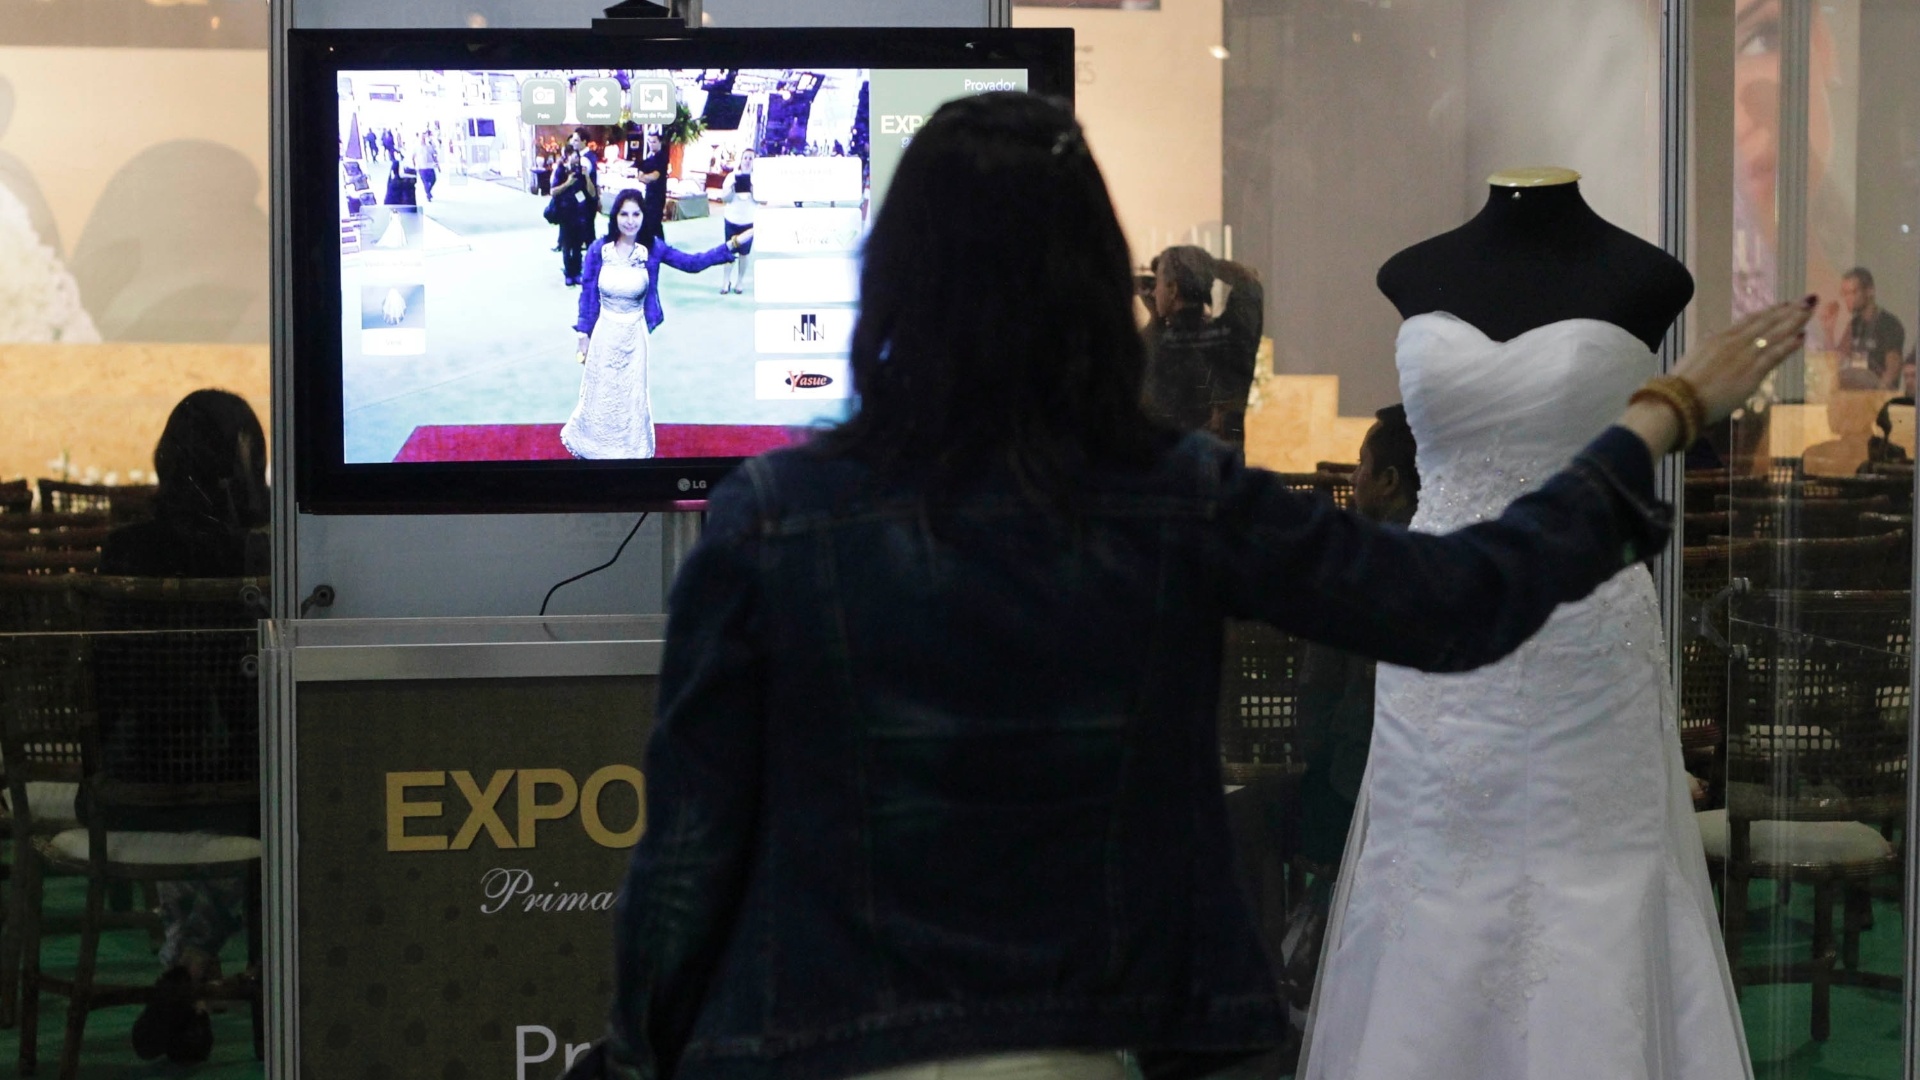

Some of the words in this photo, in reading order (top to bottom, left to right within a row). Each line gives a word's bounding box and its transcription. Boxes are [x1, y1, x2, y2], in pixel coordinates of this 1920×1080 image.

[964, 79, 1016, 91] Provador
[881, 114, 931, 134] EXP
[787, 370, 828, 393] Yasue
[692, 480, 708, 489] LG
[386, 764, 647, 852] EXPO
